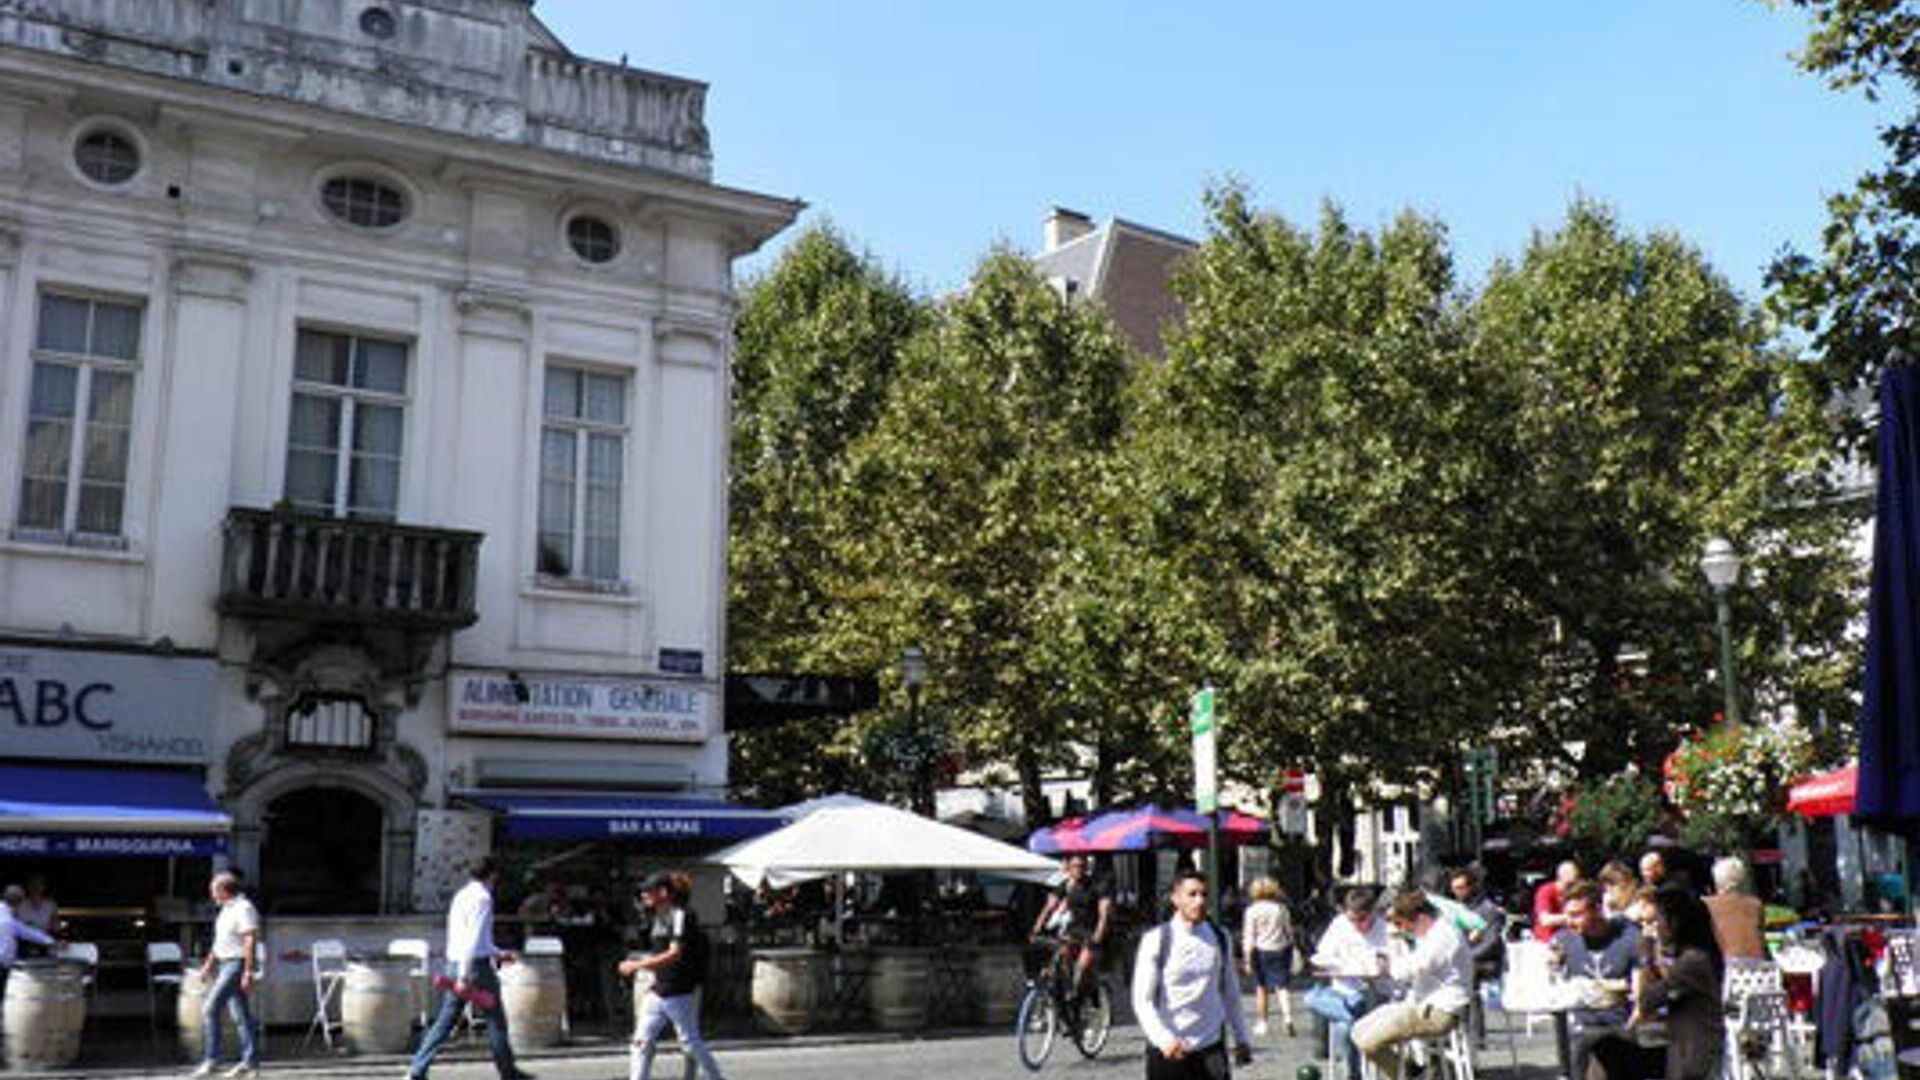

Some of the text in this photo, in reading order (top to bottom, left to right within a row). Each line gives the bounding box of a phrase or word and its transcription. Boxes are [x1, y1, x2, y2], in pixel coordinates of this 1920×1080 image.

[0, 678, 114, 731] ABC
[463, 680, 592, 708] ALIMETATION
[608, 819, 639, 834] BAR
[656, 820, 701, 835] TAPAS
